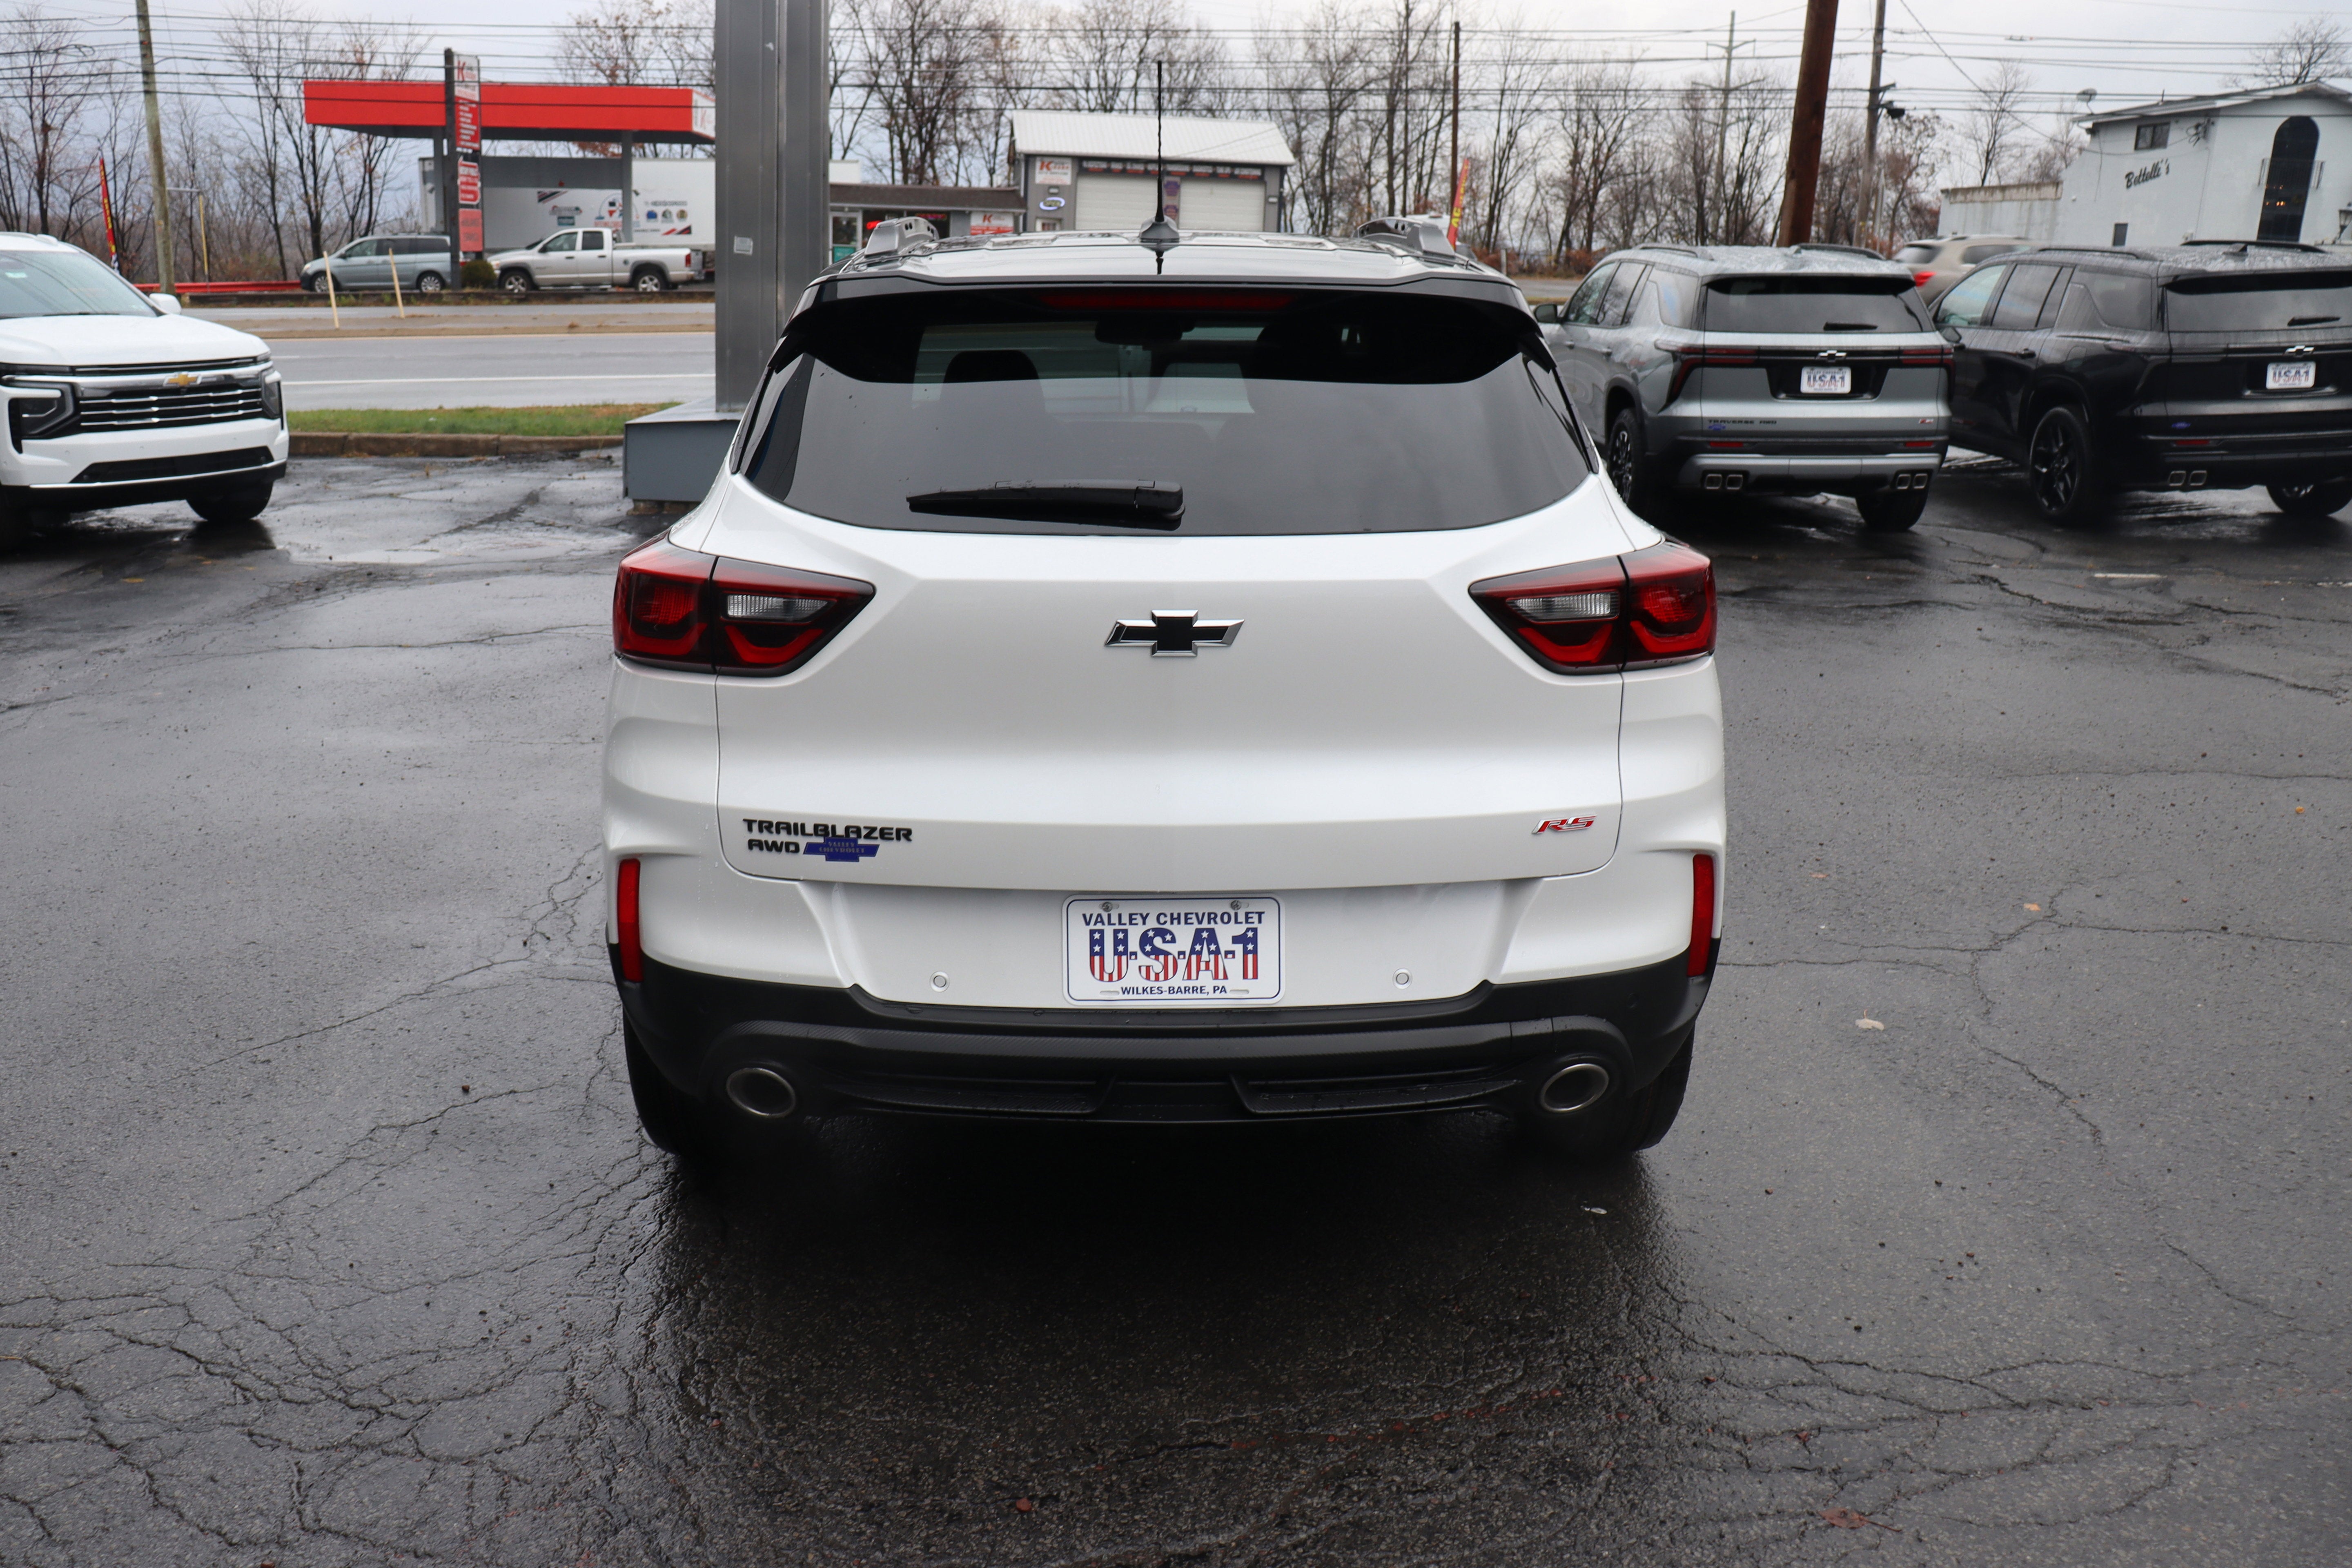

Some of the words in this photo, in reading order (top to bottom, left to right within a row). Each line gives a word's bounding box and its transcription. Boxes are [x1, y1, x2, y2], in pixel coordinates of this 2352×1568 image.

[742, 818, 913, 842] TRAILBLAZER
[1532, 814, 1597, 834] RS
[748, 838, 800, 853] AWD
[1082, 913, 1150, 926] VALLEY
[1156, 911, 1265, 926] CHEVROLET
[1121, 986, 1209, 996] WILKES-BARRE,
[1213, 986, 1227, 994] PA
